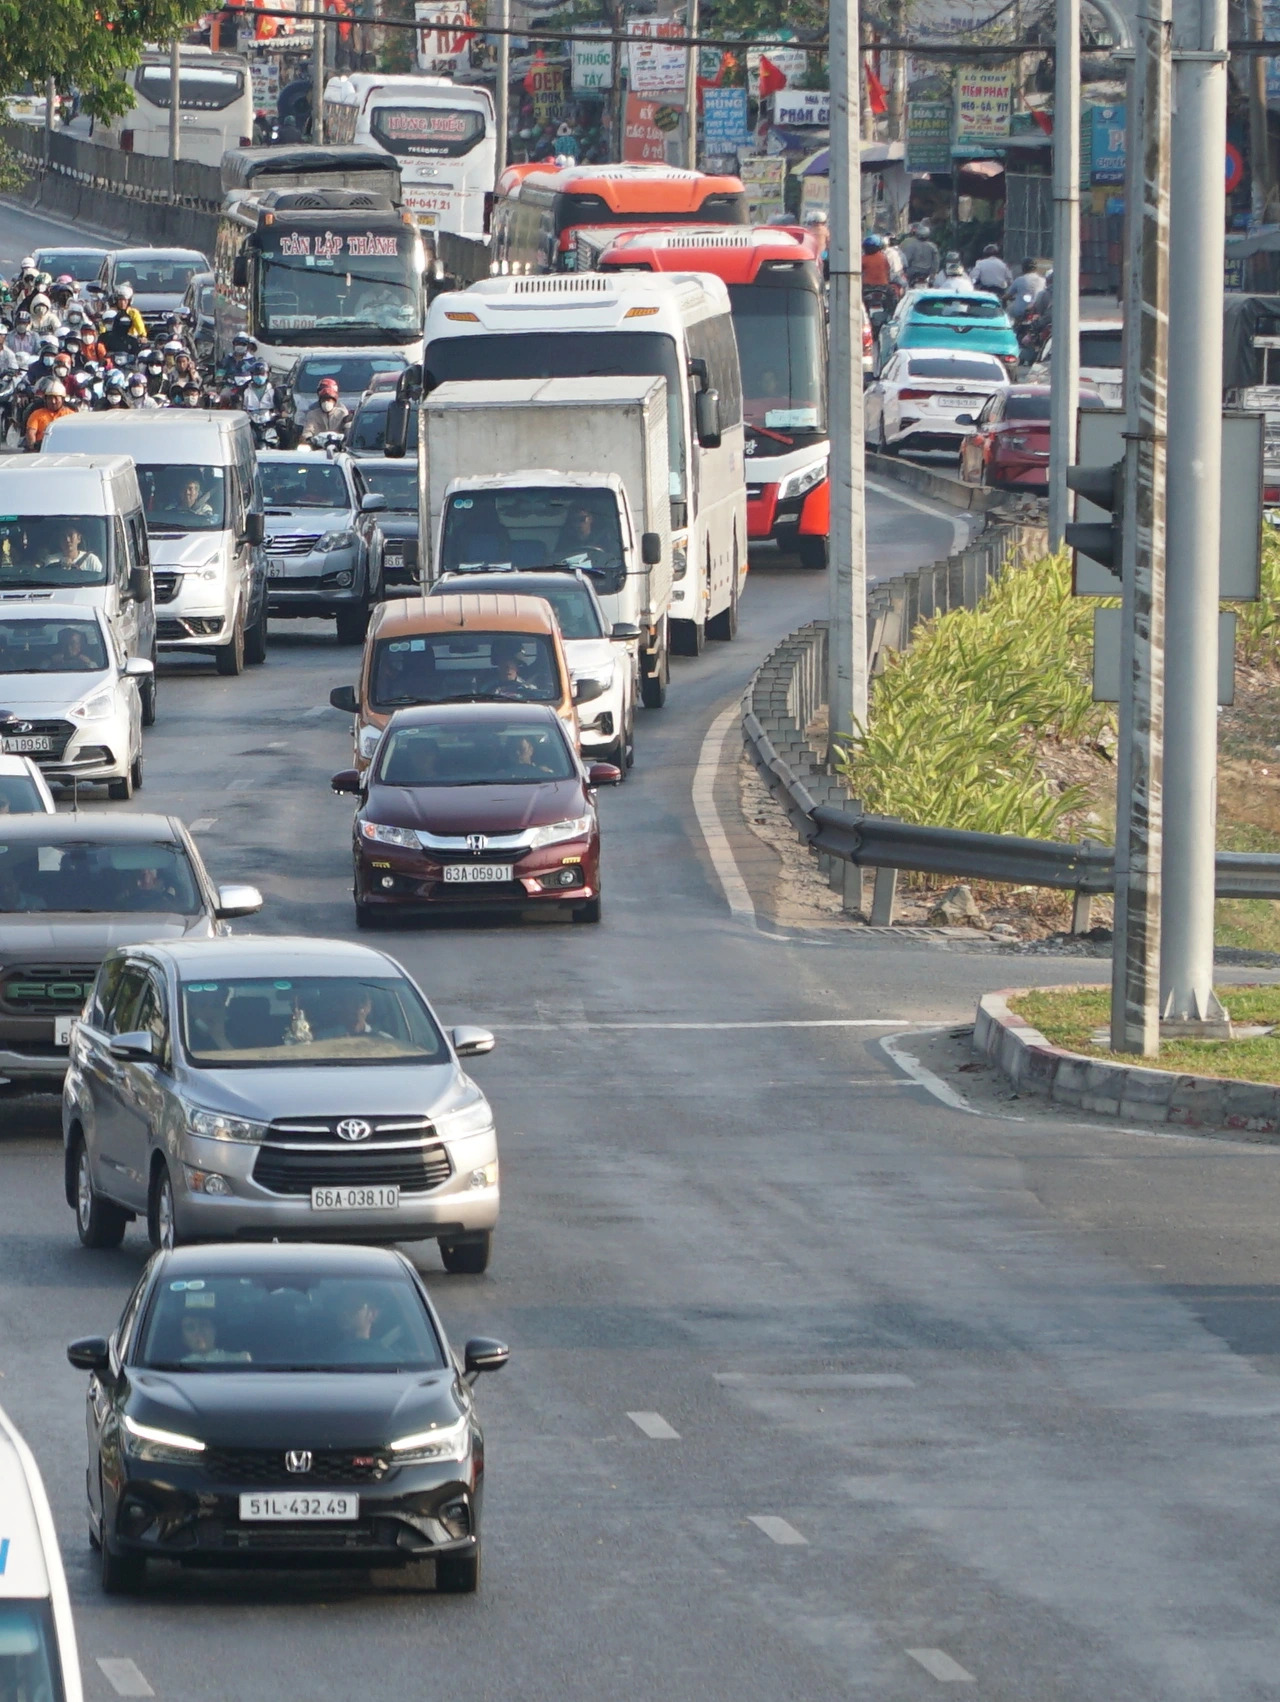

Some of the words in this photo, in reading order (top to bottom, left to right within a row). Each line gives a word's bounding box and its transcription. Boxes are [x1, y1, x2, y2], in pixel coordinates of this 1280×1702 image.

[577, 49, 610, 65] THUỐC
[280, 232, 311, 256] TÂN
[314, 231, 344, 259] LẬP
[347, 232, 398, 257] THÀNH
[3, 738, 49, 750] A-189.56
